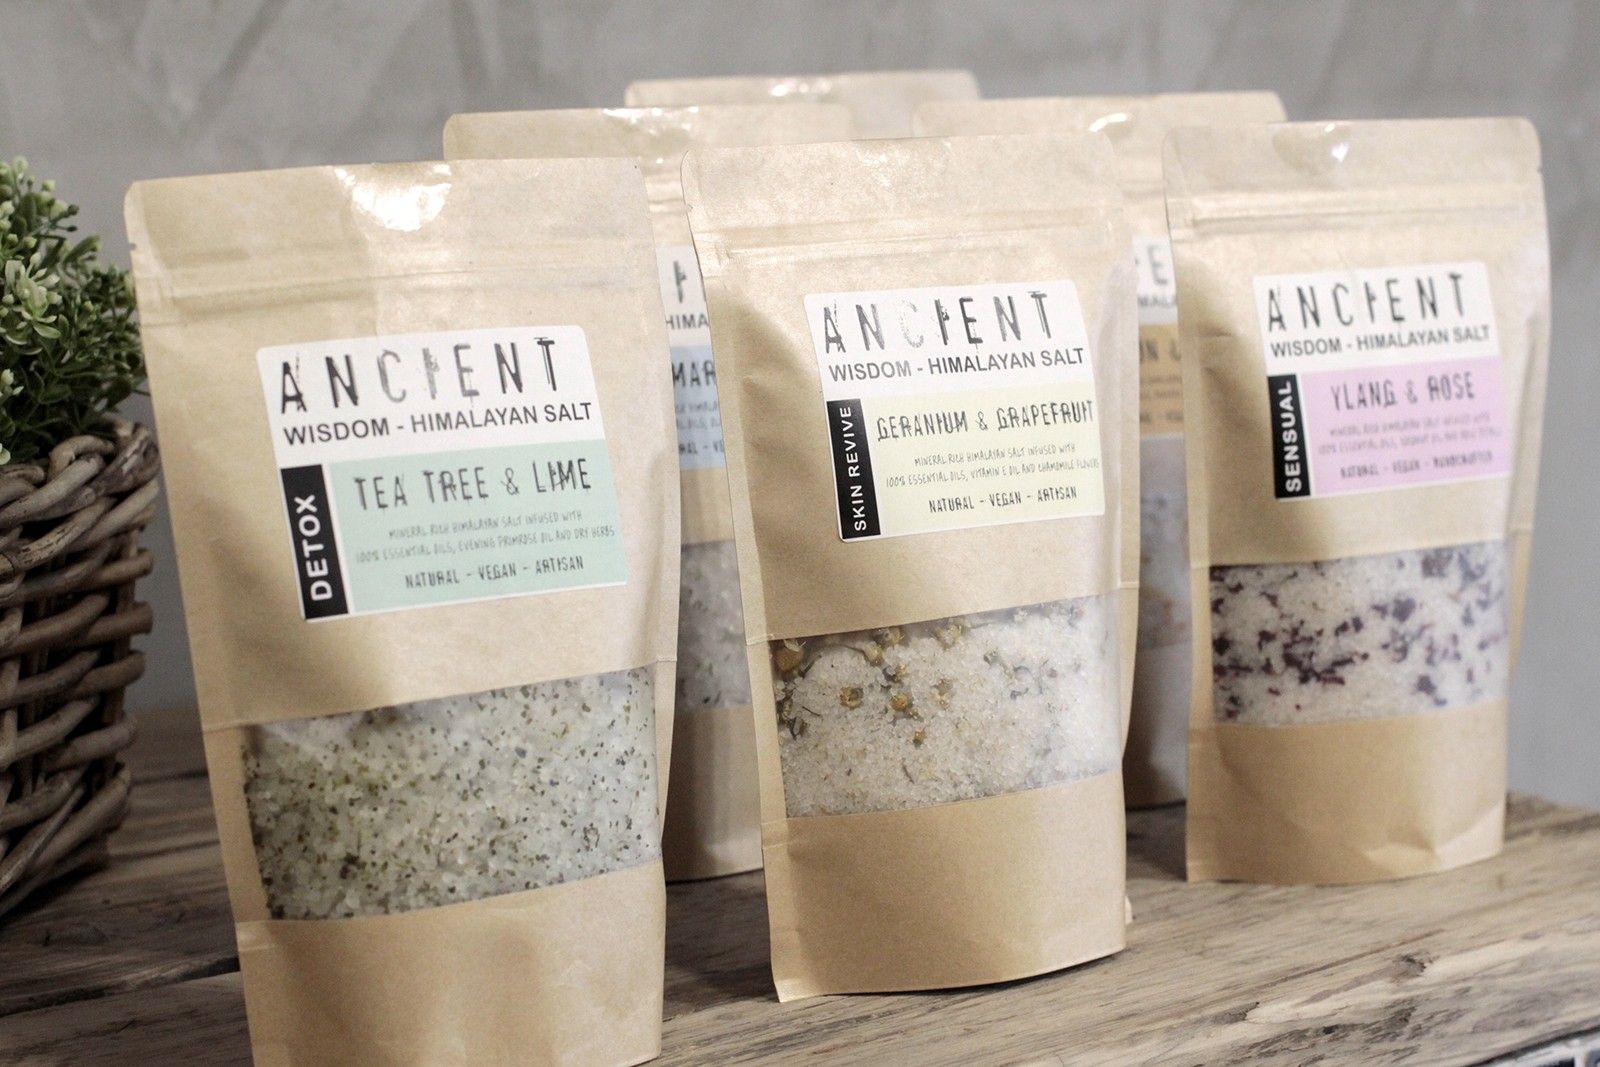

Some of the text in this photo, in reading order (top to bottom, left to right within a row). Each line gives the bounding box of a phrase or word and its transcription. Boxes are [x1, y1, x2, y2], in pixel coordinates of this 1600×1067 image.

[824, 291, 1051, 353] ANCIENT
[1269, 272, 1463, 332] ANCIENT
[1270, 338, 1341, 358] WISDOM
[1356, 330, 1448, 350] HIMALAYAN
[1454, 325, 1490, 342] SALT
[282, 337, 558, 413] ANCIENT
[828, 360, 912, 382] WISDOM
[928, 352, 1035, 374] HIMALAYAN
[1042, 348, 1084, 366] SALT
[1330, 372, 1474, 411] YLANG & ROSE
[284, 418, 390, 445] WISDOM
[411, 405, 538, 433] HIMALAYAN
[544, 402, 592, 422] SALT
[876, 400, 1093, 441] GERANIUM & GRAPEFRUIT
[1278, 381, 1302, 492] SENSUAL
[840, 406, 867, 531] SKIN REVIVE
[914, 454, 946, 466] MINERAL
[967, 448, 1005, 462] HIMALAYAN
[1008, 447, 1024, 458] SALT
[1028, 444, 1056, 456] INFUSED
[354, 458, 591, 510] TEA TREE & LIME
[886, 476, 906, 488] 100%
[908, 472, 948, 486] ESSENTIAL
[971, 466, 999, 479] VITAMIN
[929, 496, 974, 512] NATURAL
[989, 491, 1021, 507] VEGAN
[1037, 486, 1076, 502] ARTISAN
[294, 494, 334, 601] DETOX
[405, 569, 460, 589] NATURAL
[478, 562, 516, 580] VEGAN
[536, 556, 584, 574] ARTISAN
